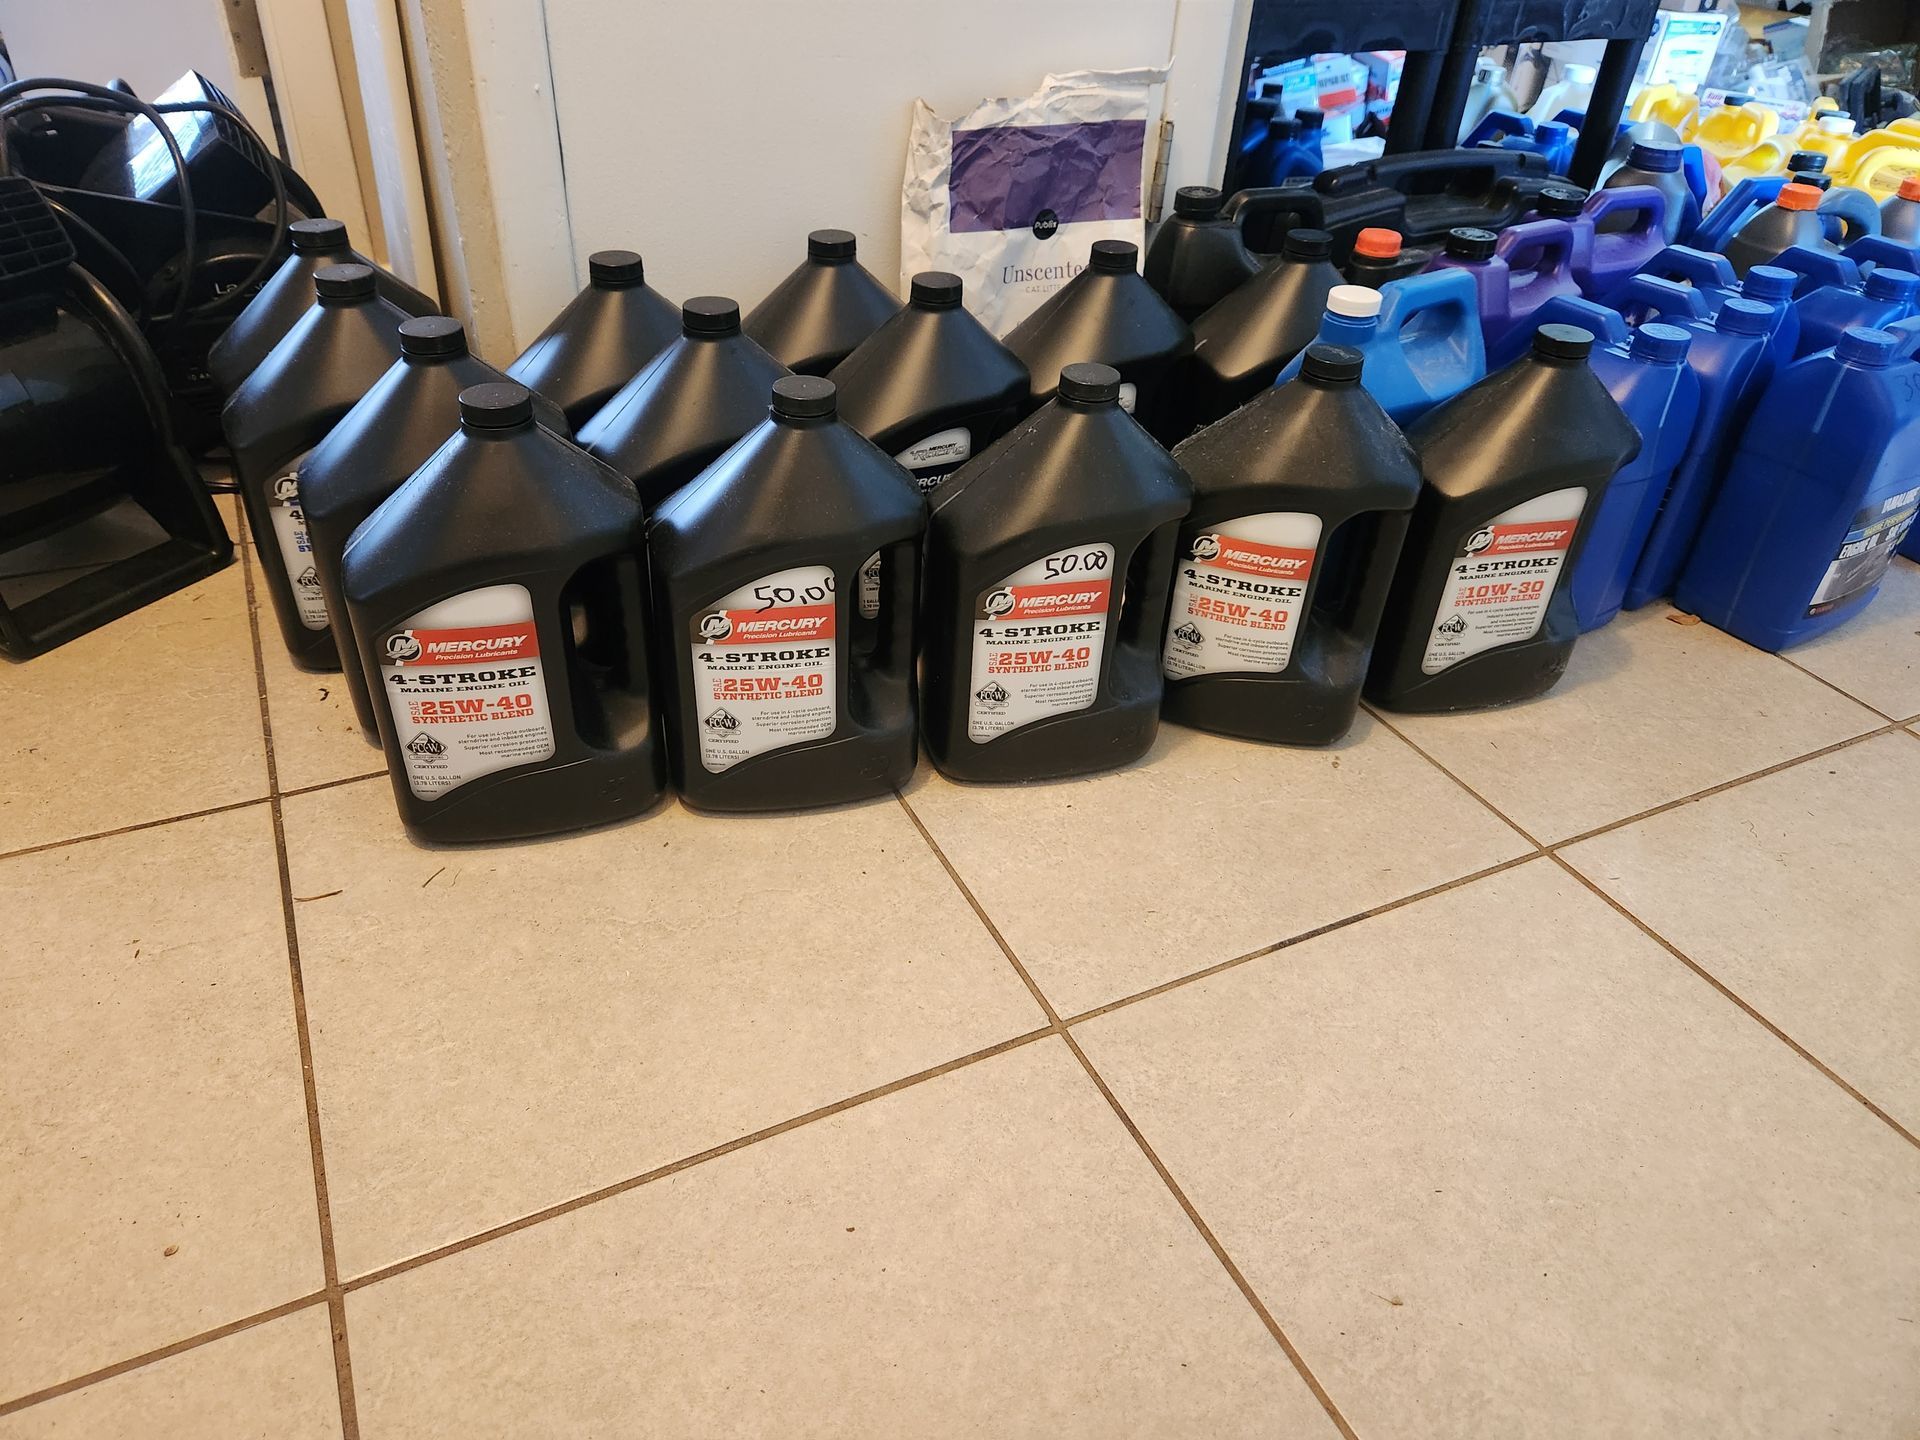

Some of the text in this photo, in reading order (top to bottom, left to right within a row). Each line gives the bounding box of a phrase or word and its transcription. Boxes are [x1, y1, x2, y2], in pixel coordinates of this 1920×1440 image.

[1025, 285, 1040, 293] CAT
[1495, 531, 1567, 545] MERCURY
[1044, 551, 1108, 580] 50.00
[1223, 549, 1307, 569] MERCURY
[1455, 557, 1559, 573] 4-STROKE
[1183, 568, 1301, 597] 4-STROKE
[1465, 580, 1545, 599] 10W-30
[1188, 581, 1230, 595] MARINE
[1232, 592, 1273, 602] ENGINE
[1018, 592, 1102, 608] MERCURY
[1454, 596, 1508, 607] SYNTHETIC
[1024, 604, 1092, 615] Precision Lubricants
[1198, 596, 1288, 623] 25W-40
[736, 616, 828, 633] MERCURY
[1187, 607, 1286, 631] SYNTHETIC BLEND
[743, 629, 817, 640] Precision Lubricants
[978, 622, 1100, 638] 4-STROKE
[427, 634, 528, 654] MERCURY
[475, 648, 518, 658] Lubricants
[698, 648, 830, 663] 4-STROKE
[989, 653, 998, 666] SAE
[998, 647, 1090, 666] 25W-40
[758, 662, 802, 670] ENGINE
[988, 660, 1089, 674] SYNTHETIC BLEND
[389, 665, 536, 685] 4-STROKE
[723, 674, 823, 692] 25W-40
[457, 683, 505, 692] ENGINE
[713, 678, 722, 692] SAE
[714, 687, 823, 700] SYNTHETIC BLEND
[408, 701, 420, 715] SAE
[420, 693, 532, 715] 25W-40
[412, 708, 534, 724] SYNTHETIC BLEND
